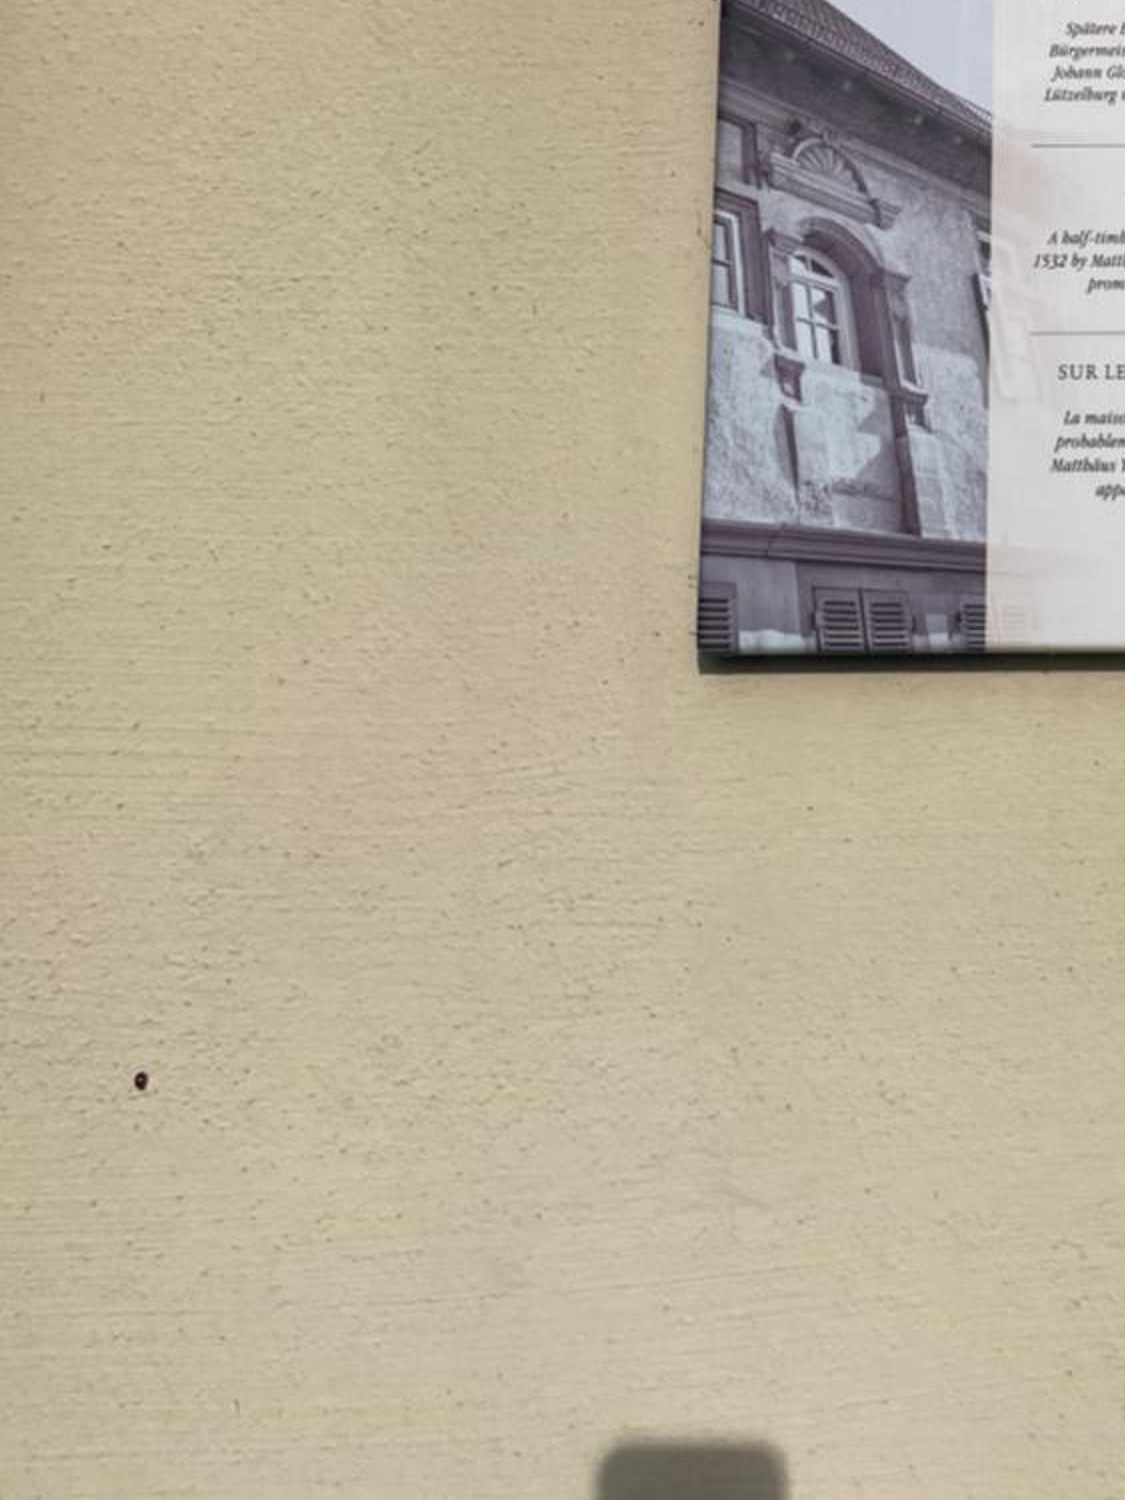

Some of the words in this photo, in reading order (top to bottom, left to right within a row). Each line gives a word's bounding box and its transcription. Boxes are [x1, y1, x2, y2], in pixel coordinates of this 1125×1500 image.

[1064, 21, 1116, 40] Spätere
[1050, 64, 1103, 83] Johann
[1043, 86, 1118, 106] Lützelburg
[1046, 231, 1058, 246] A
[1033, 252, 1068, 270] 1532
[1070, 252, 1087, 272] by
[1057, 364, 1099, 381] SUR
[1063, 410, 1081, 426] La
[1050, 456, 1117, 473] Matthäus
